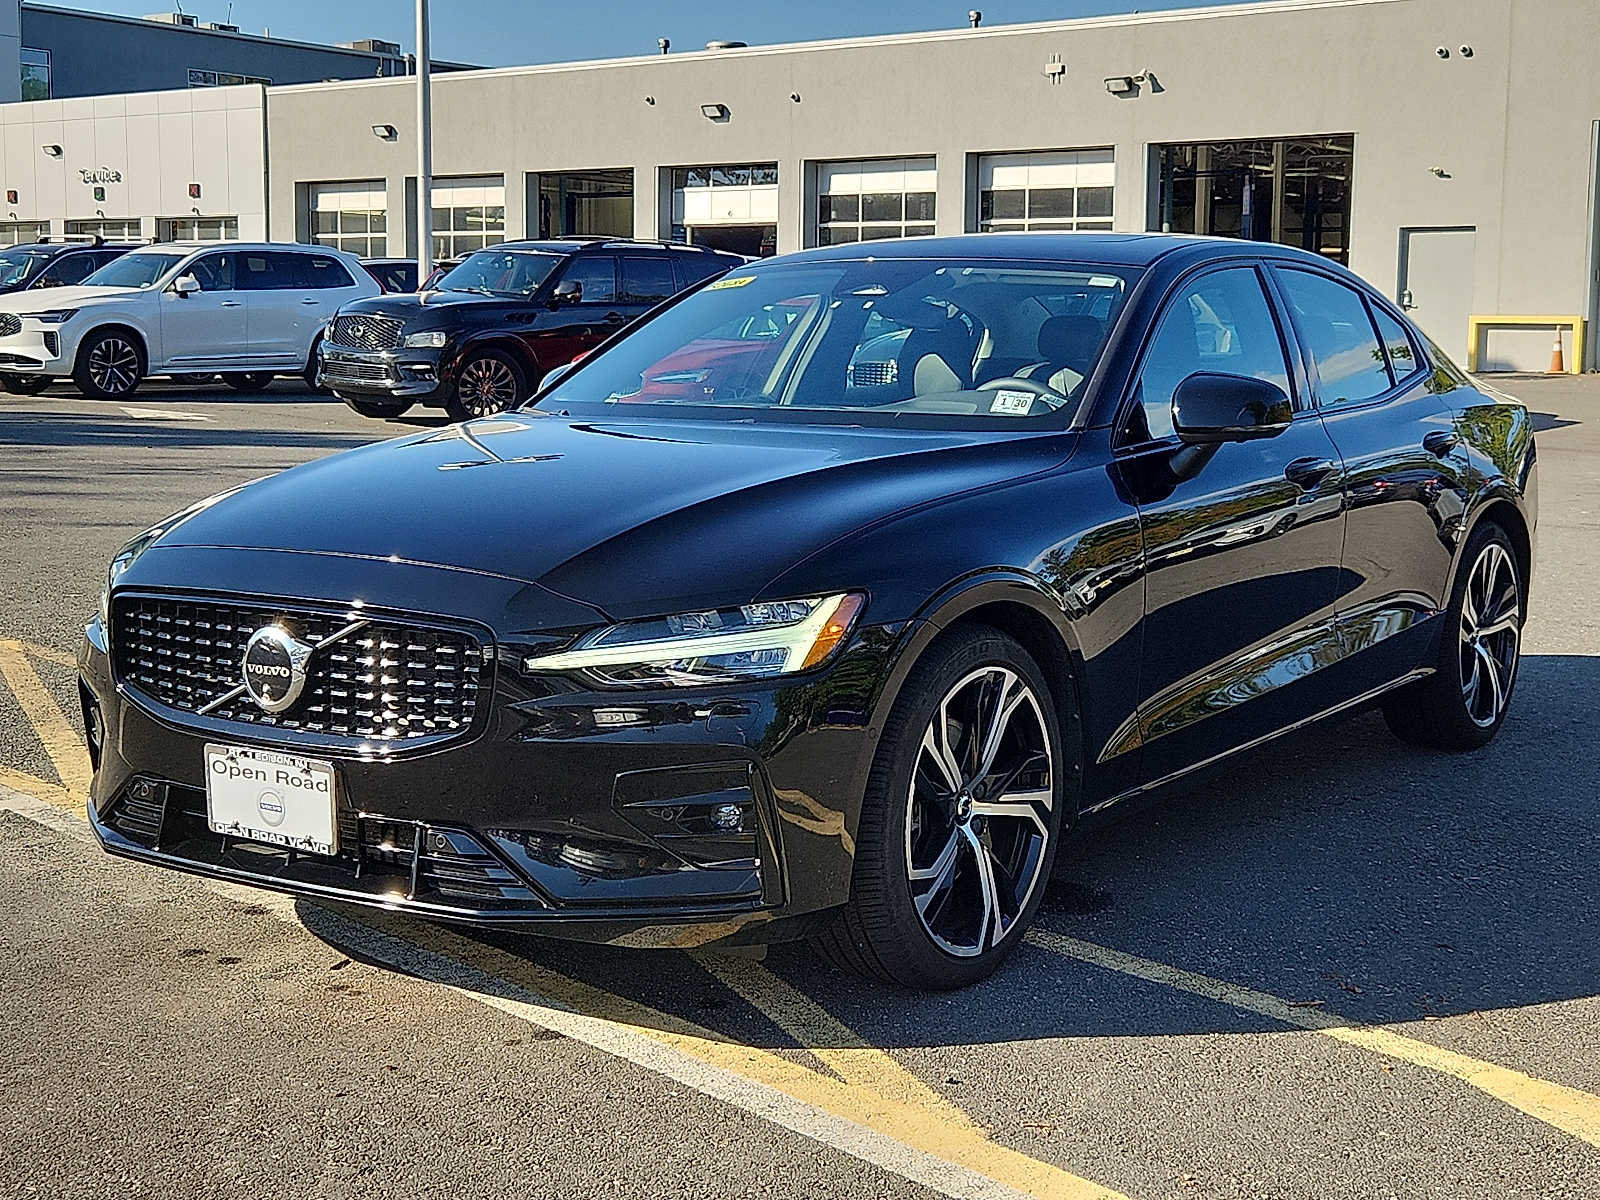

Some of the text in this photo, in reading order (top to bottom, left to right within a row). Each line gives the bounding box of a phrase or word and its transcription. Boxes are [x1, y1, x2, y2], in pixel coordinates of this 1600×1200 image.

[1001, 397, 1006, 406] 1
[1014, 399, 1028, 408] 30
[247, 663, 290, 678] VOLVO
[212, 760, 328, 792] Open Road
[251, 829, 286, 845] ROAD
